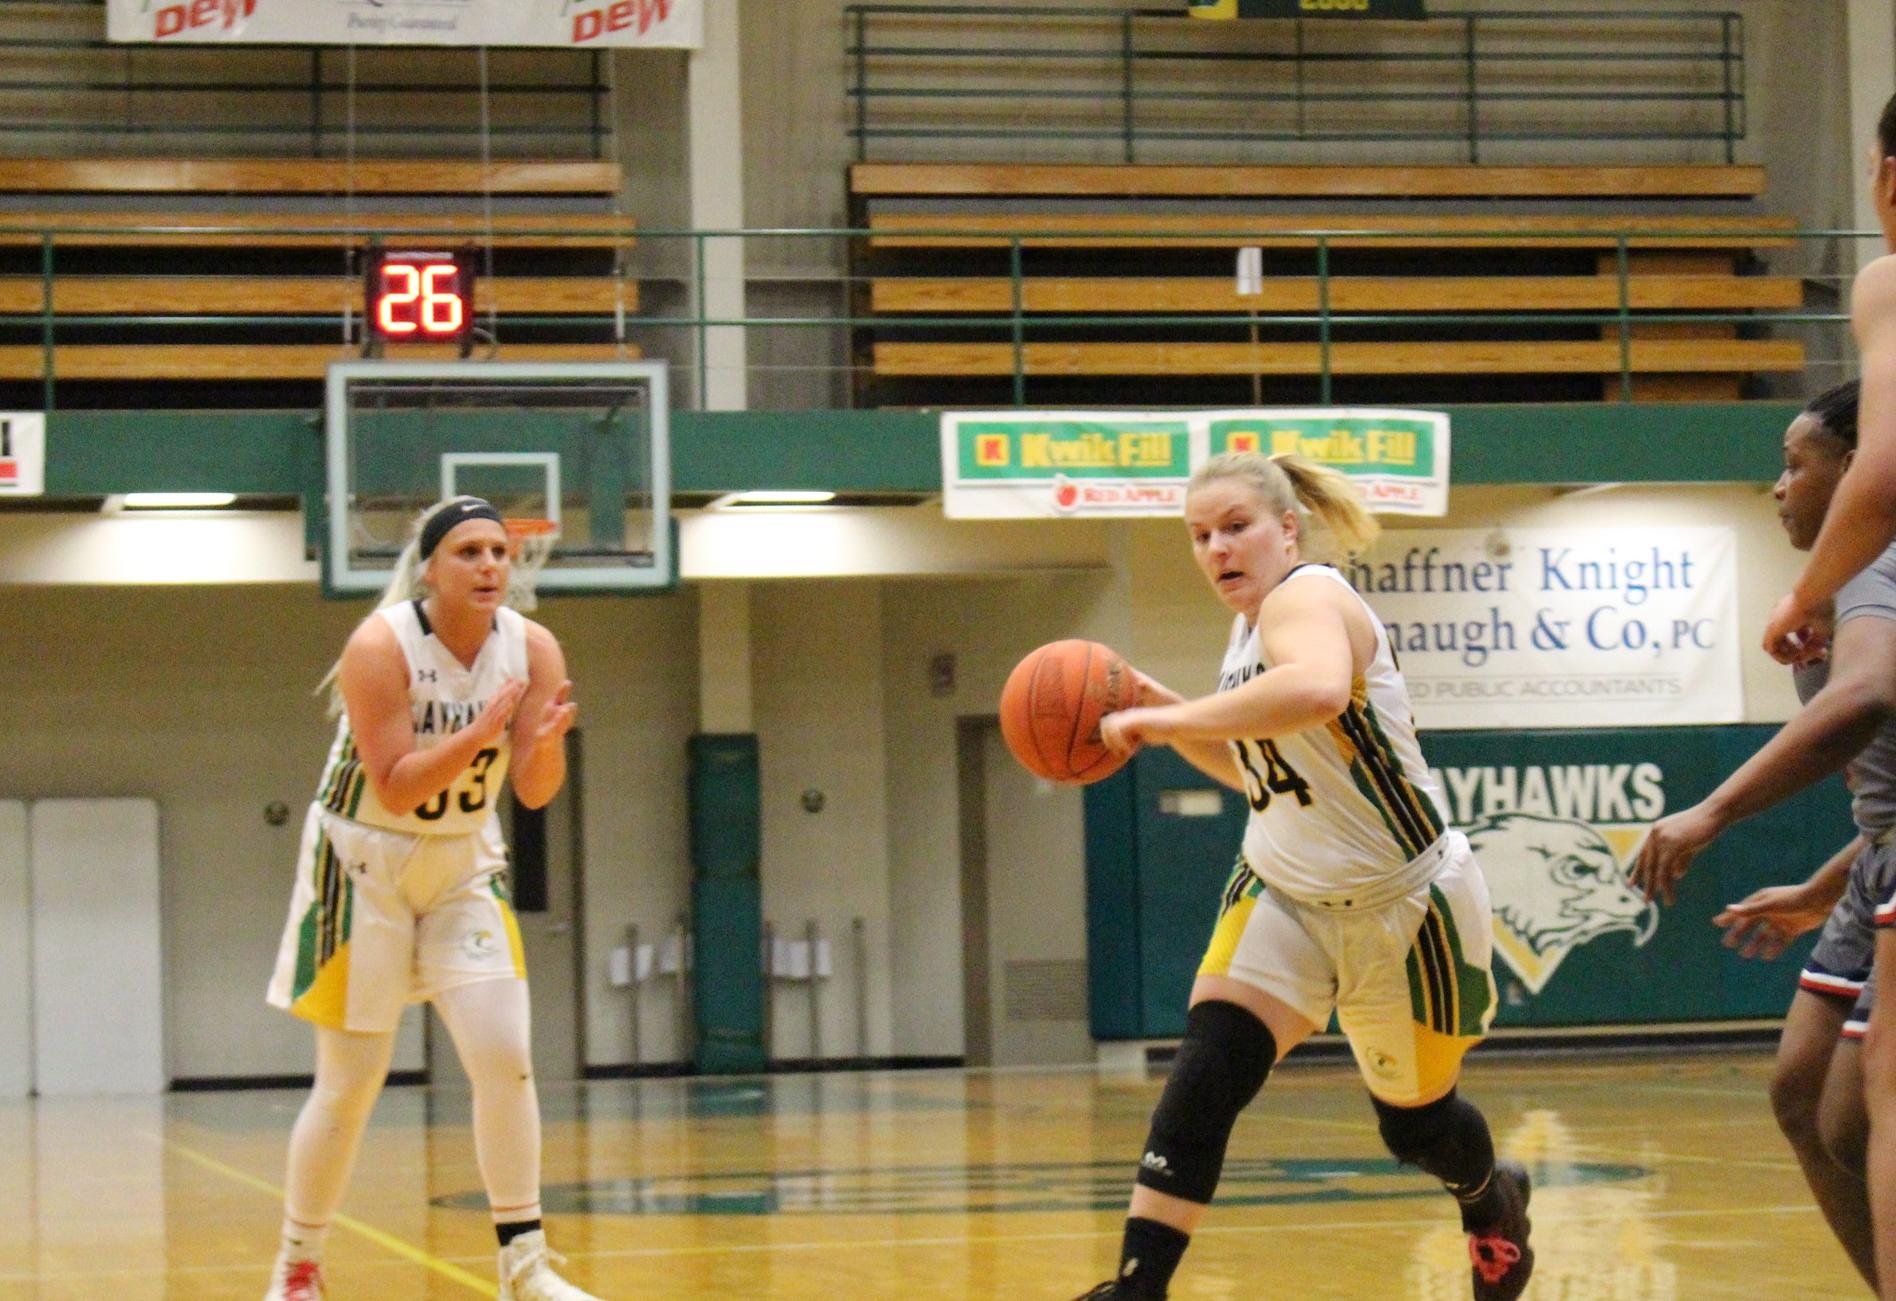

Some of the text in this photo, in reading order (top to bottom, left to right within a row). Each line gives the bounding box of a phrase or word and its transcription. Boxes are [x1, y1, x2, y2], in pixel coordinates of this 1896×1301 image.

[379, 264, 462, 332] 26
[1021, 432, 1118, 467] Kwik
[1119, 432, 1172, 467] Fill
[1366, 430, 1417, 466] Fill
[1083, 487, 1178, 502] RED APPLE
[1349, 547, 1695, 606] haffner Knight
[1384, 606, 1518, 668] naugh
[1531, 605, 1571, 651] &
[1672, 618, 1716, 650] PC
[1436, 679, 1512, 698] PUBLIC
[1521, 677, 1682, 697] ACCOUNTANTS
[1429, 762, 1666, 824] YHAWKS
